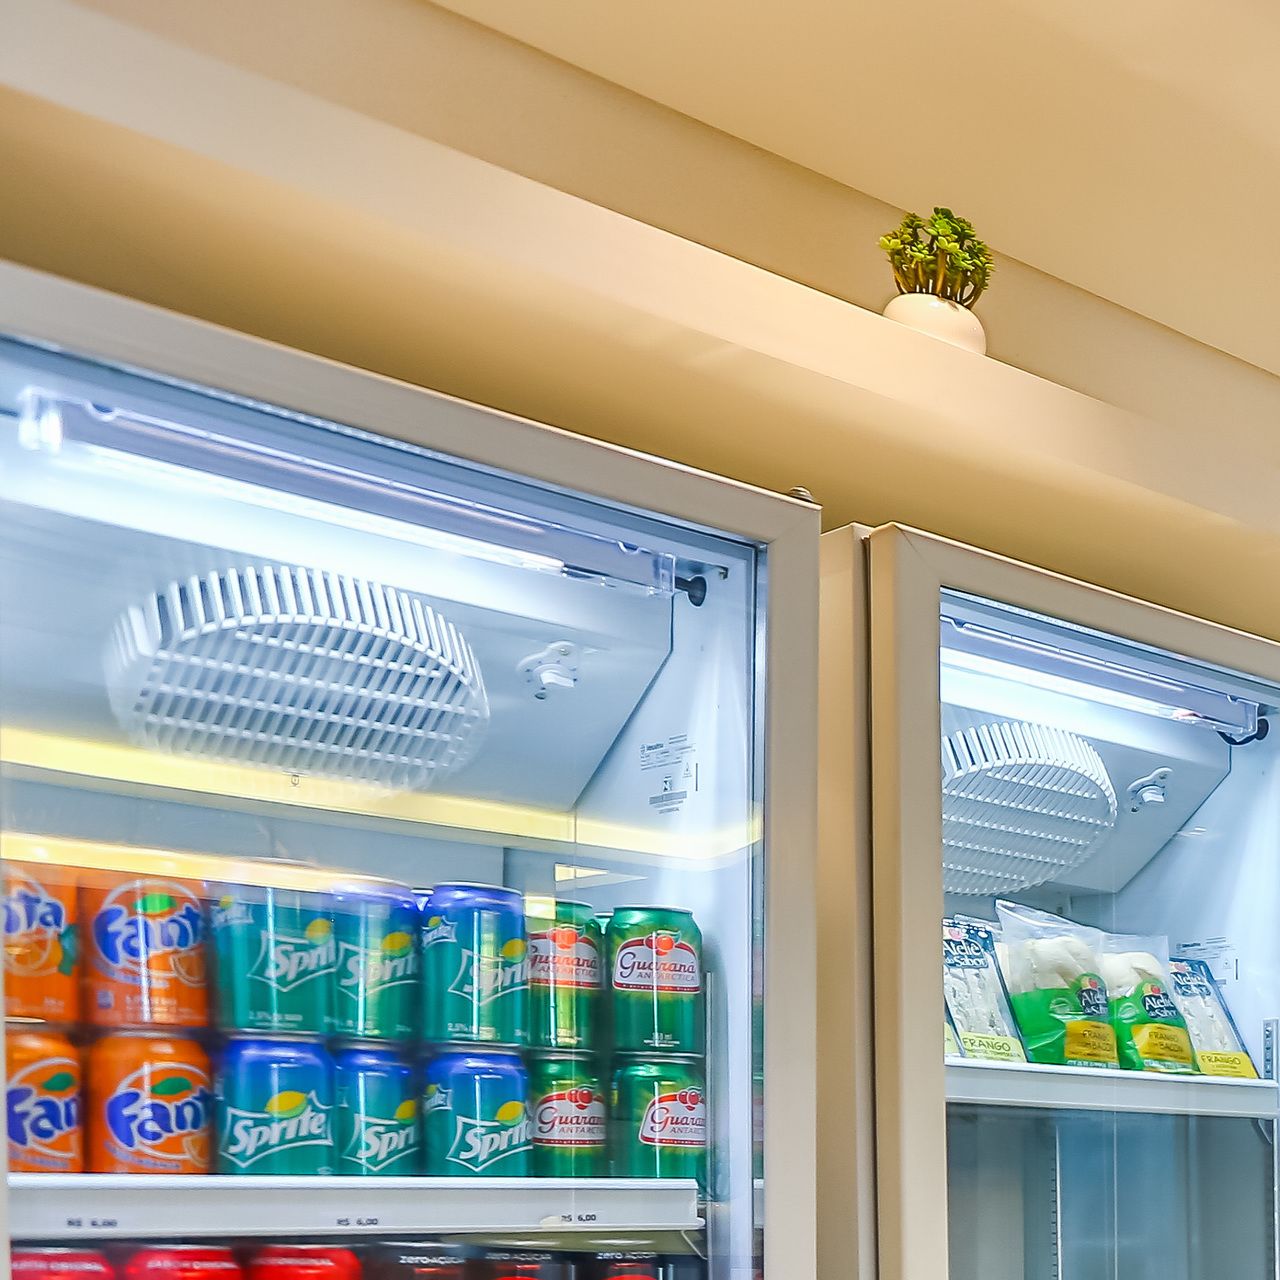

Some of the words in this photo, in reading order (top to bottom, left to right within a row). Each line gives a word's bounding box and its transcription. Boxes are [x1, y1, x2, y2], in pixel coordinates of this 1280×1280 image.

[93, 901, 205, 967] Fant
[620, 951, 696, 979] Guaraná
[962, 1037, 1011, 1052] FRANGO
[1201, 1055, 1241, 1066] FRANGO
[229, 1107, 327, 1156] Sprite
[538, 1106, 605, 1134] Guaran
[651, 1106, 706, 1134] Guara
[578, 1214, 597, 1222] 6,00
